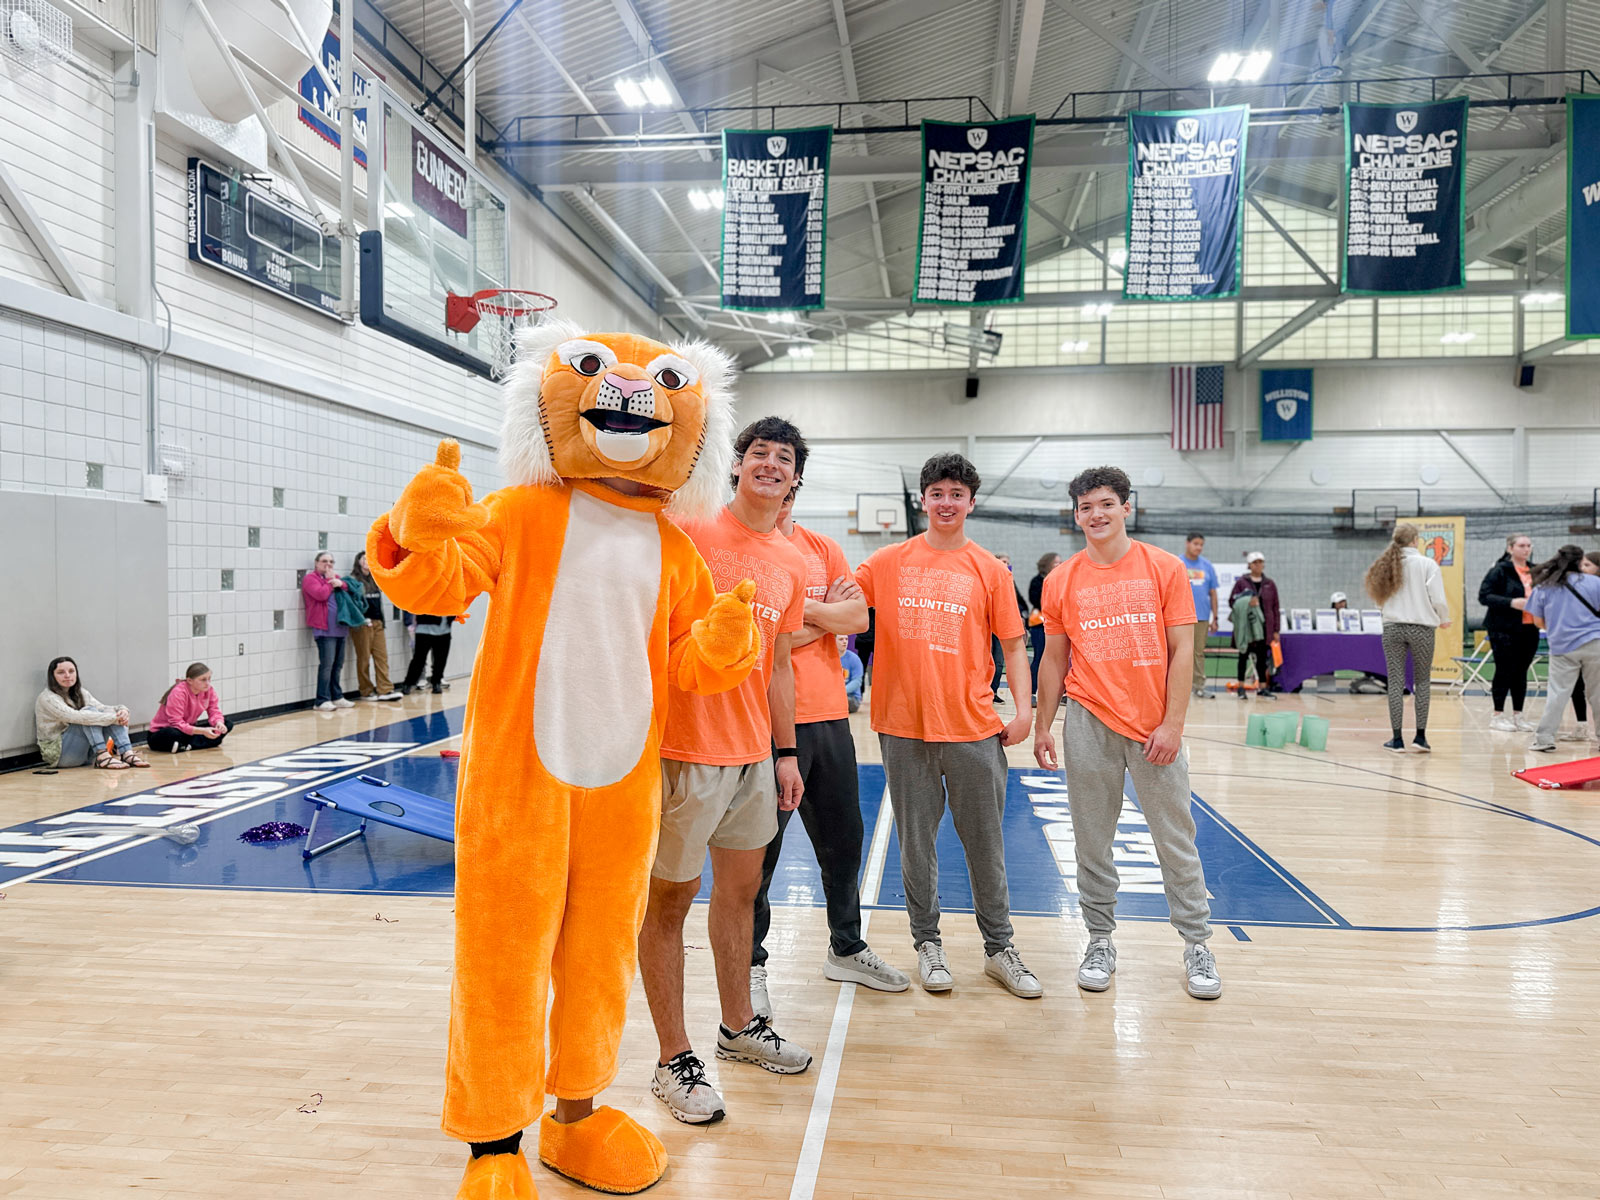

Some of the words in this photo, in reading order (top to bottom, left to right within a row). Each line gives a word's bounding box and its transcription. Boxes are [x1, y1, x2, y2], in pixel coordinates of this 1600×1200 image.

[1182, 122, 1195, 130] W
[1400, 114, 1414, 125] W
[972, 132, 984, 140] W
[1354, 130, 1458, 154] NEPSAC
[771, 140, 783, 150] W
[1138, 138, 1238, 160] NEPSAC
[928, 147, 1025, 170] NEPSAC
[1360, 150, 1452, 168] CHAMPIONS
[728, 156, 824, 177] BASKETBALL
[1142, 158, 1232, 176] CHAMPIONS
[934, 166, 1019, 184] CHAMPIONS
[1394, 169, 1424, 180] HOCKEY
[752, 178, 780, 191] POINT
[782, 174, 824, 190] SCORERS
[963, 184, 999, 195] LACROSSE
[1391, 178, 1438, 191] BASKETBALL
[1174, 188, 1192, 198] GOLF
[1394, 192, 1406, 202] ICE
[1406, 189, 1438, 202] HOCKEY
[188, 168, 196, 244] FAIR-PLAY.COM
[962, 206, 989, 216] SOCCER
[1393, 202, 1406, 212] ICE
[1406, 200, 1438, 212] HOCKEY
[961, 216, 988, 227] SOCCER
[1174, 220, 1202, 230] SOCCER
[1393, 223, 1424, 235] HOCKEY
[962, 228, 984, 238] CROSS
[985, 224, 1016, 238] COUNTRY
[1174, 232, 1201, 241] SOCCER
[961, 237, 1006, 248] BASKETBALL
[1391, 232, 1440, 246] BASKETBALL
[1173, 242, 1200, 252] SOCCER
[1391, 246, 1416, 257] TRACK
[222, 248, 248, 271] BONUS
[266, 260, 292, 281] PERIOD
[1172, 264, 1200, 274] SQUASH
[1169, 273, 1216, 284] BASKETBALL
[320, 293, 335, 309] BON
[1264, 388, 1309, 402] WILLISTON
[1280, 404, 1292, 413] W
[900, 566, 974, 585] VOLUNTEER
[898, 576, 972, 595] VOLUNTEER
[1076, 578, 1155, 600] VOLUNTEER
[898, 586, 970, 605] VOLUNTEER
[1076, 589, 1156, 610] VOLUNTEER
[898, 597, 968, 616] VOLUNTEER
[1078, 600, 1156, 620] VOLUNTEER
[898, 608, 964, 626] VOLUNTEER
[1080, 612, 1156, 630] VOLUNTEER
[898, 618, 961, 637] VOLUNTEER
[1080, 624, 1158, 642] VOLUNTEER
[898, 628, 959, 647] VOLUNTEER
